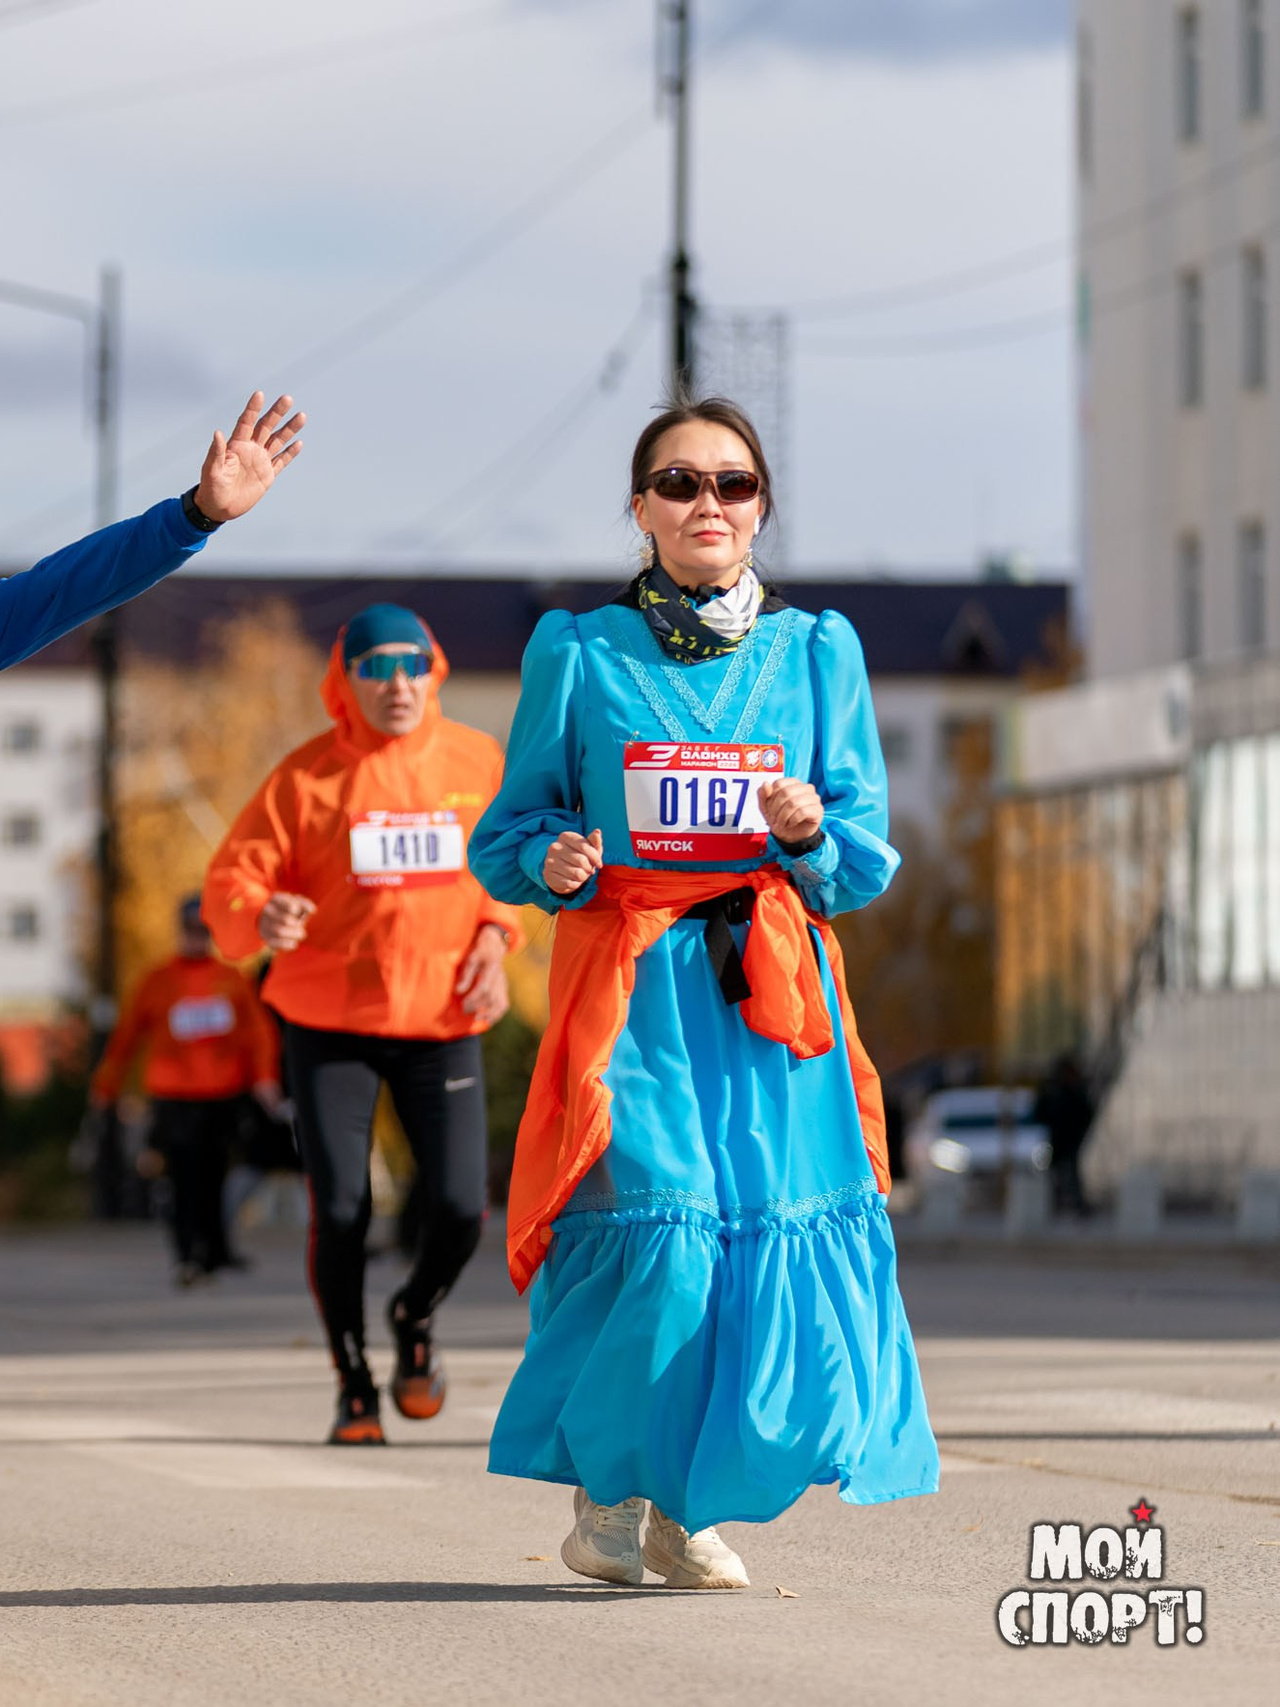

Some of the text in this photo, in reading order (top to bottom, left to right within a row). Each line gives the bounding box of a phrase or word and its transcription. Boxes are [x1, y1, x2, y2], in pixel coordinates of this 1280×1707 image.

[680, 751, 740, 760] ОЛОНХО
[659, 776, 750, 828] 0167
[381, 832, 438, 865] 1410
[636, 839, 693, 852] ЯКУТСК
